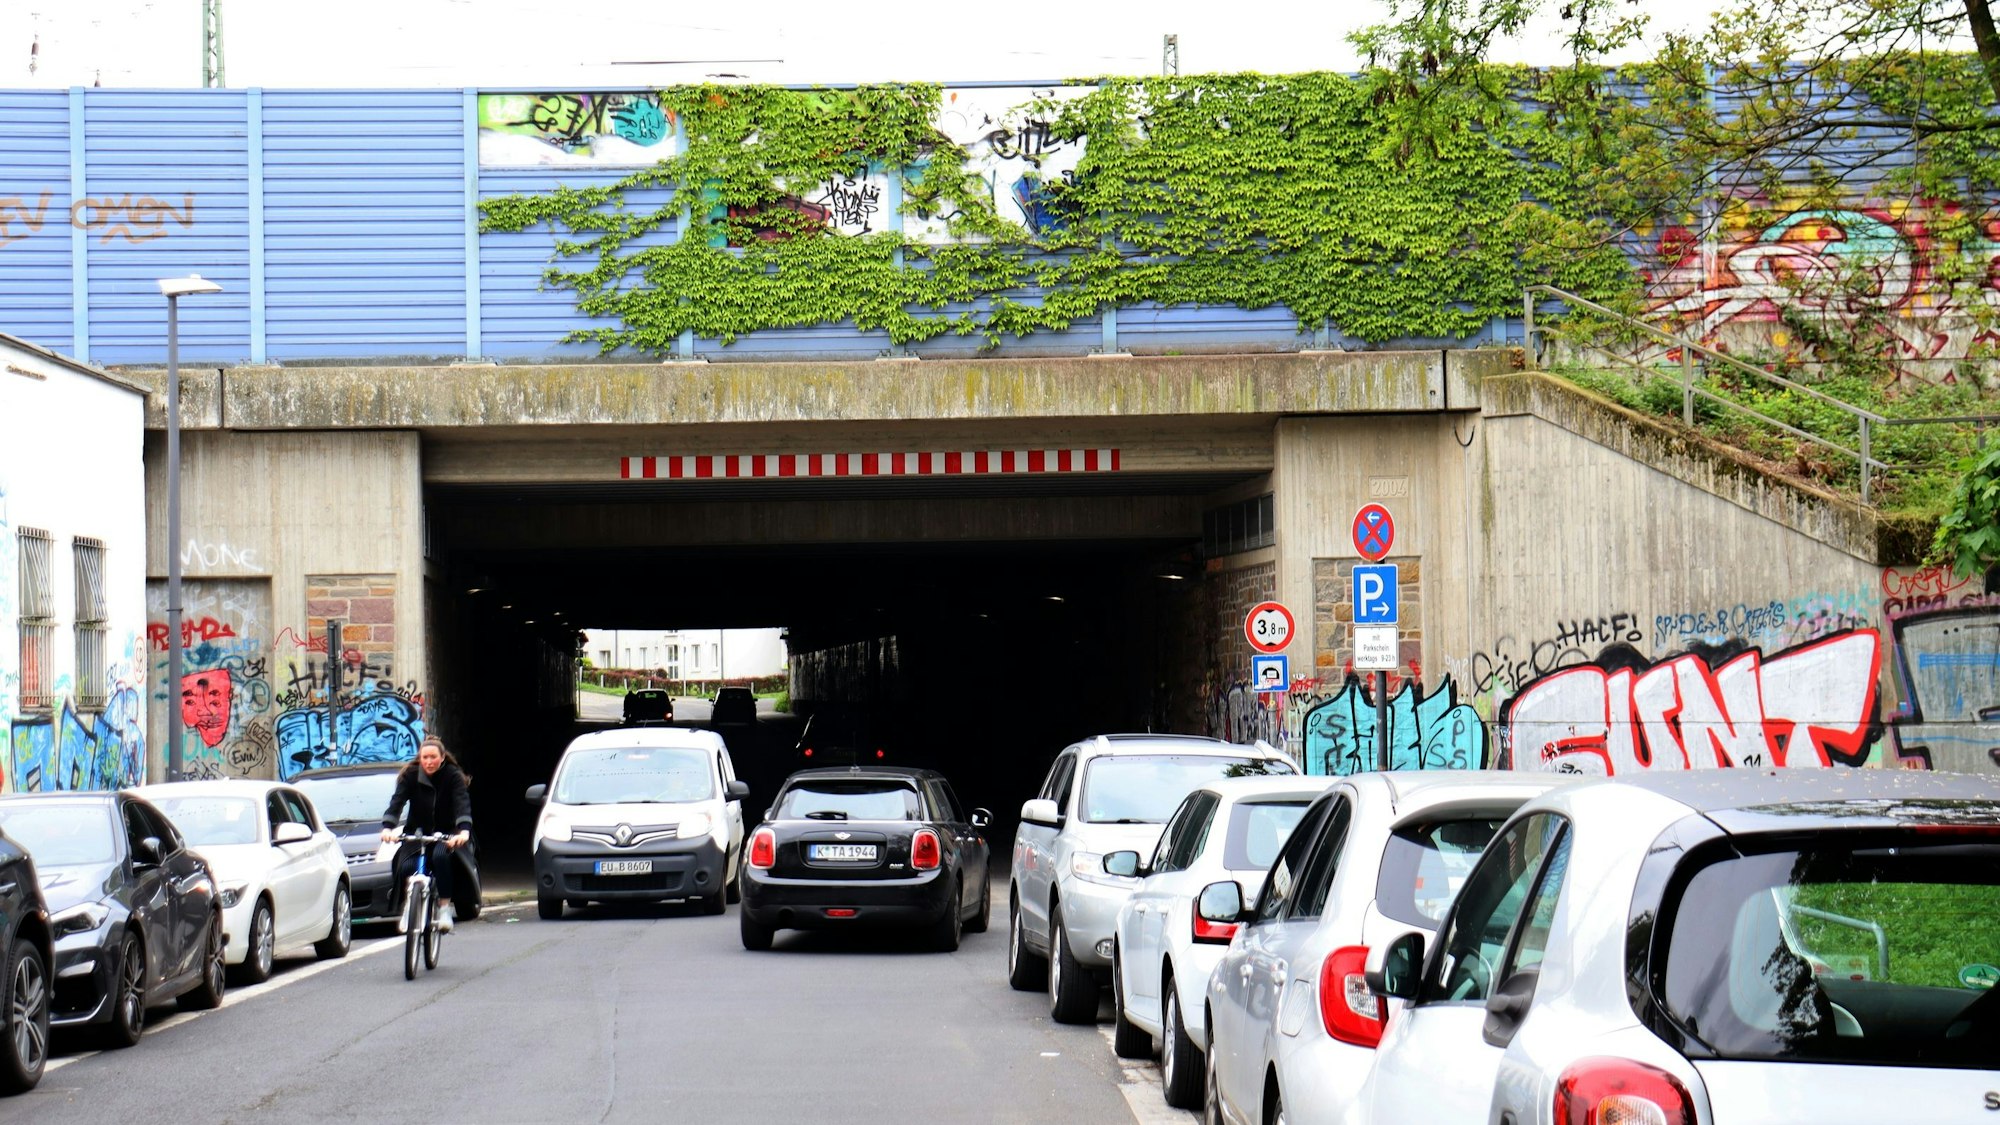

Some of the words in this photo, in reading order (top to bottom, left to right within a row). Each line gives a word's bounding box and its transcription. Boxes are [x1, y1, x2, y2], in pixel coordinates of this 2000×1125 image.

[1373, 480, 1408, 497] 2004
[1360, 573, 1384, 617] P
[1257, 619, 1276, 637] 3,8
[1278, 626, 1286, 635] m
[1363, 644, 1390, 652] Parkschein
[1357, 654, 1378, 664] werktags
[817, 847, 824, 857] K
[832, 847, 846, 857] TA
[848, 847, 875, 857] 1944
[601, 862, 613, 871] EU
[619, 862, 625, 871] B
[627, 861, 651, 871] 8607
